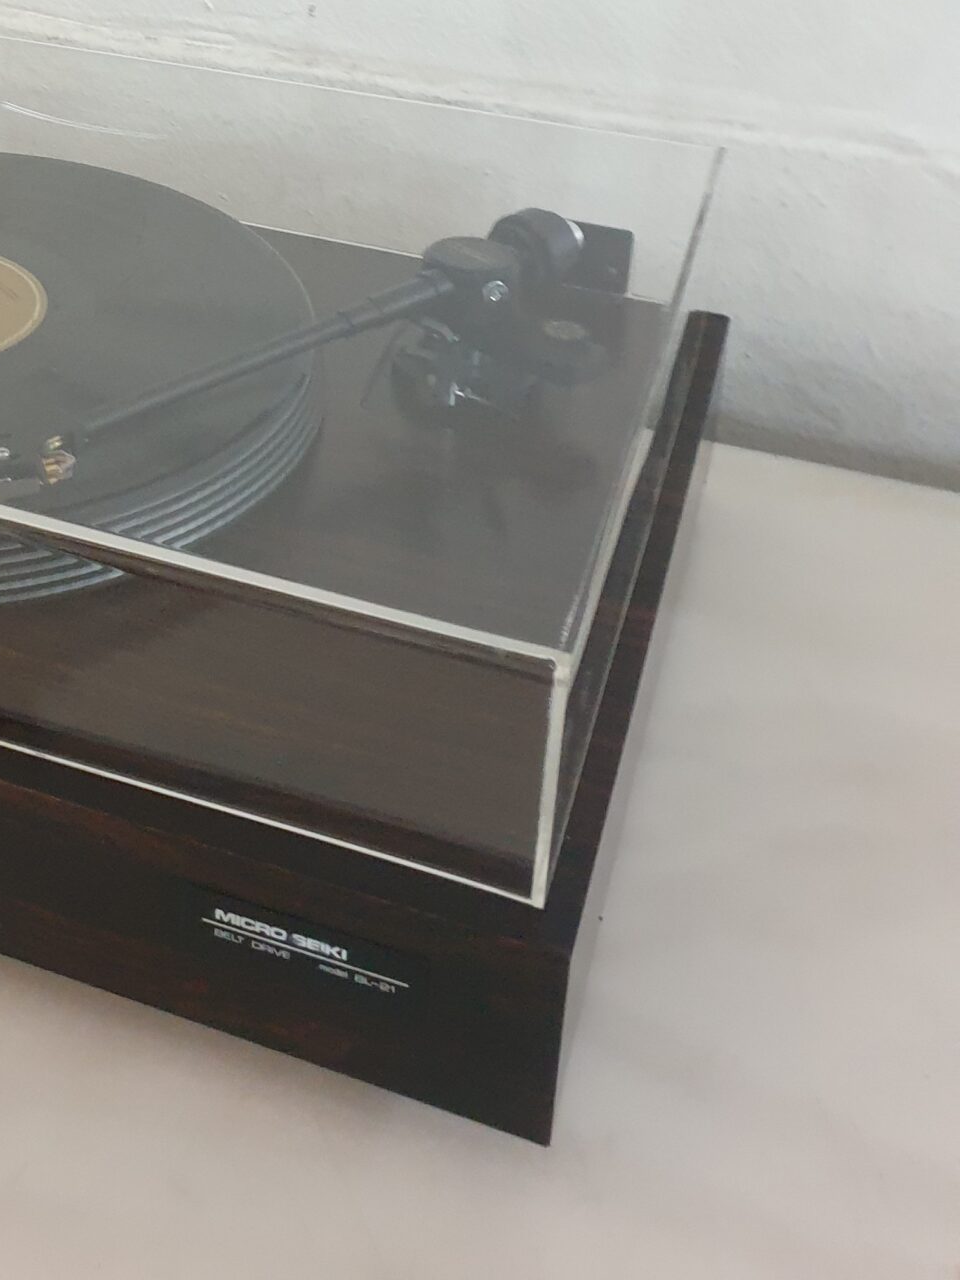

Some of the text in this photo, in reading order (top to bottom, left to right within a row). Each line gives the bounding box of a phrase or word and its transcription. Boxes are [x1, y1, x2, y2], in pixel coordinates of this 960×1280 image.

[214, 908, 348, 962] MICRO SEIKI
[214, 928, 245, 945] BELT
[251, 940, 291, 960] DRIVE
